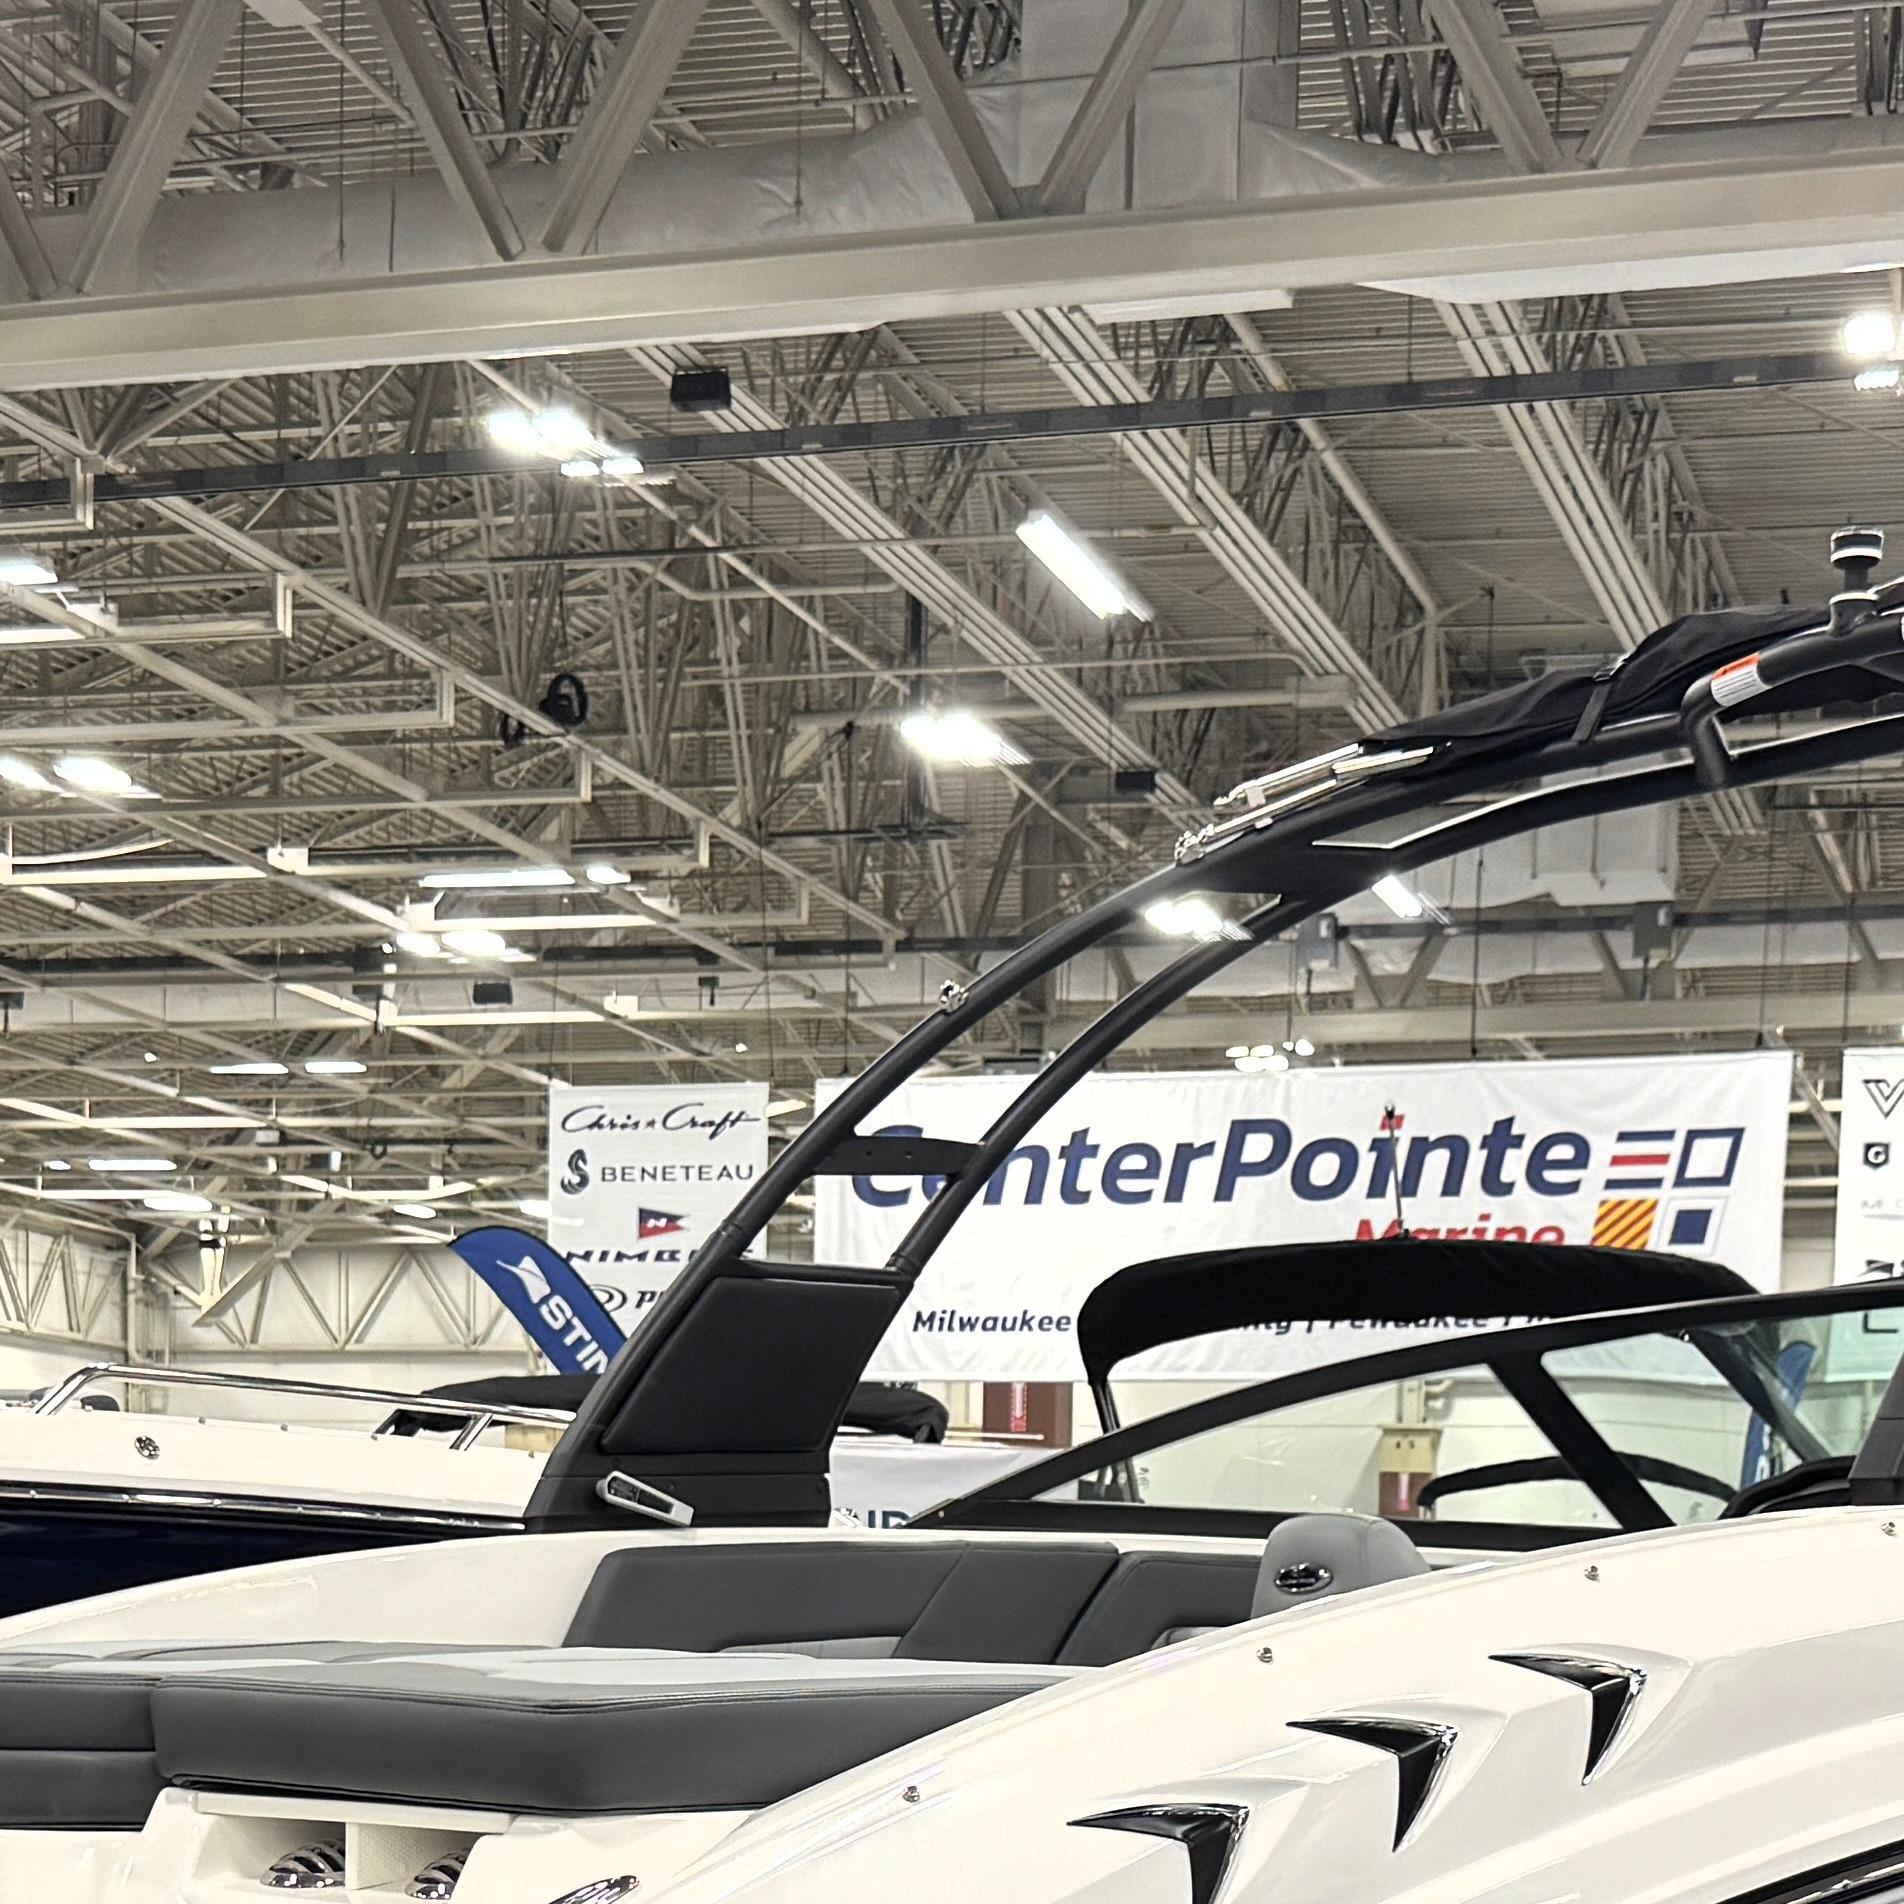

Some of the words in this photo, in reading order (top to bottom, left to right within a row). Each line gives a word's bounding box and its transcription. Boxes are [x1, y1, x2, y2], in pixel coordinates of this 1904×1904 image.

[561, 1104, 641, 1134] Chris
[662, 1102, 761, 1140] Craft
[851, 1113, 1591, 1208] CnterPointe
[601, 1165, 754, 1183] BENETEAU
[565, 1249, 754, 1263] NIMB
[912, 1309, 1072, 1334] Milwaukee
